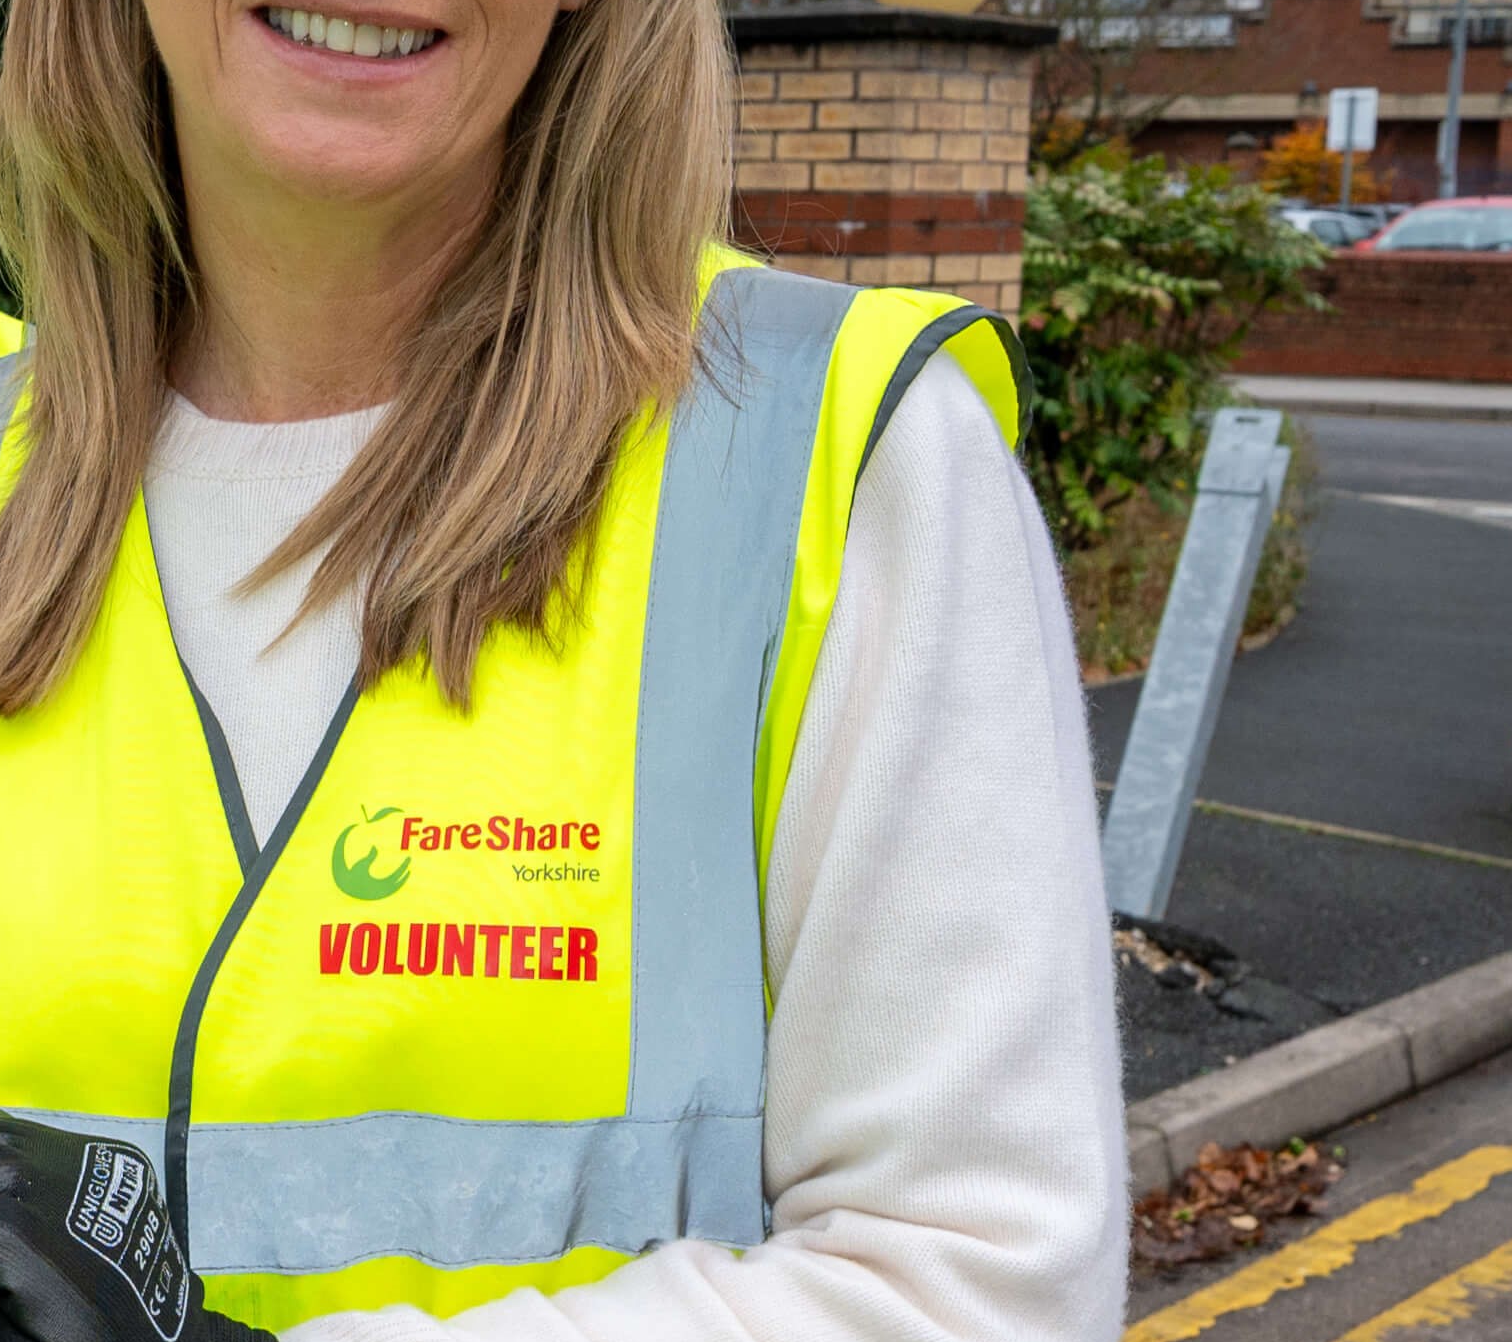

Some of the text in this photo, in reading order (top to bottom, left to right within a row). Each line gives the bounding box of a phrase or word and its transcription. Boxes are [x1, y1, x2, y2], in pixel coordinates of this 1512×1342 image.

[400, 815, 601, 852] FareShare
[512, 862, 601, 883] Yorkshire
[318, 921, 599, 982] VOLUNTEER
[75, 1147, 113, 1232] UNIGLOVES
